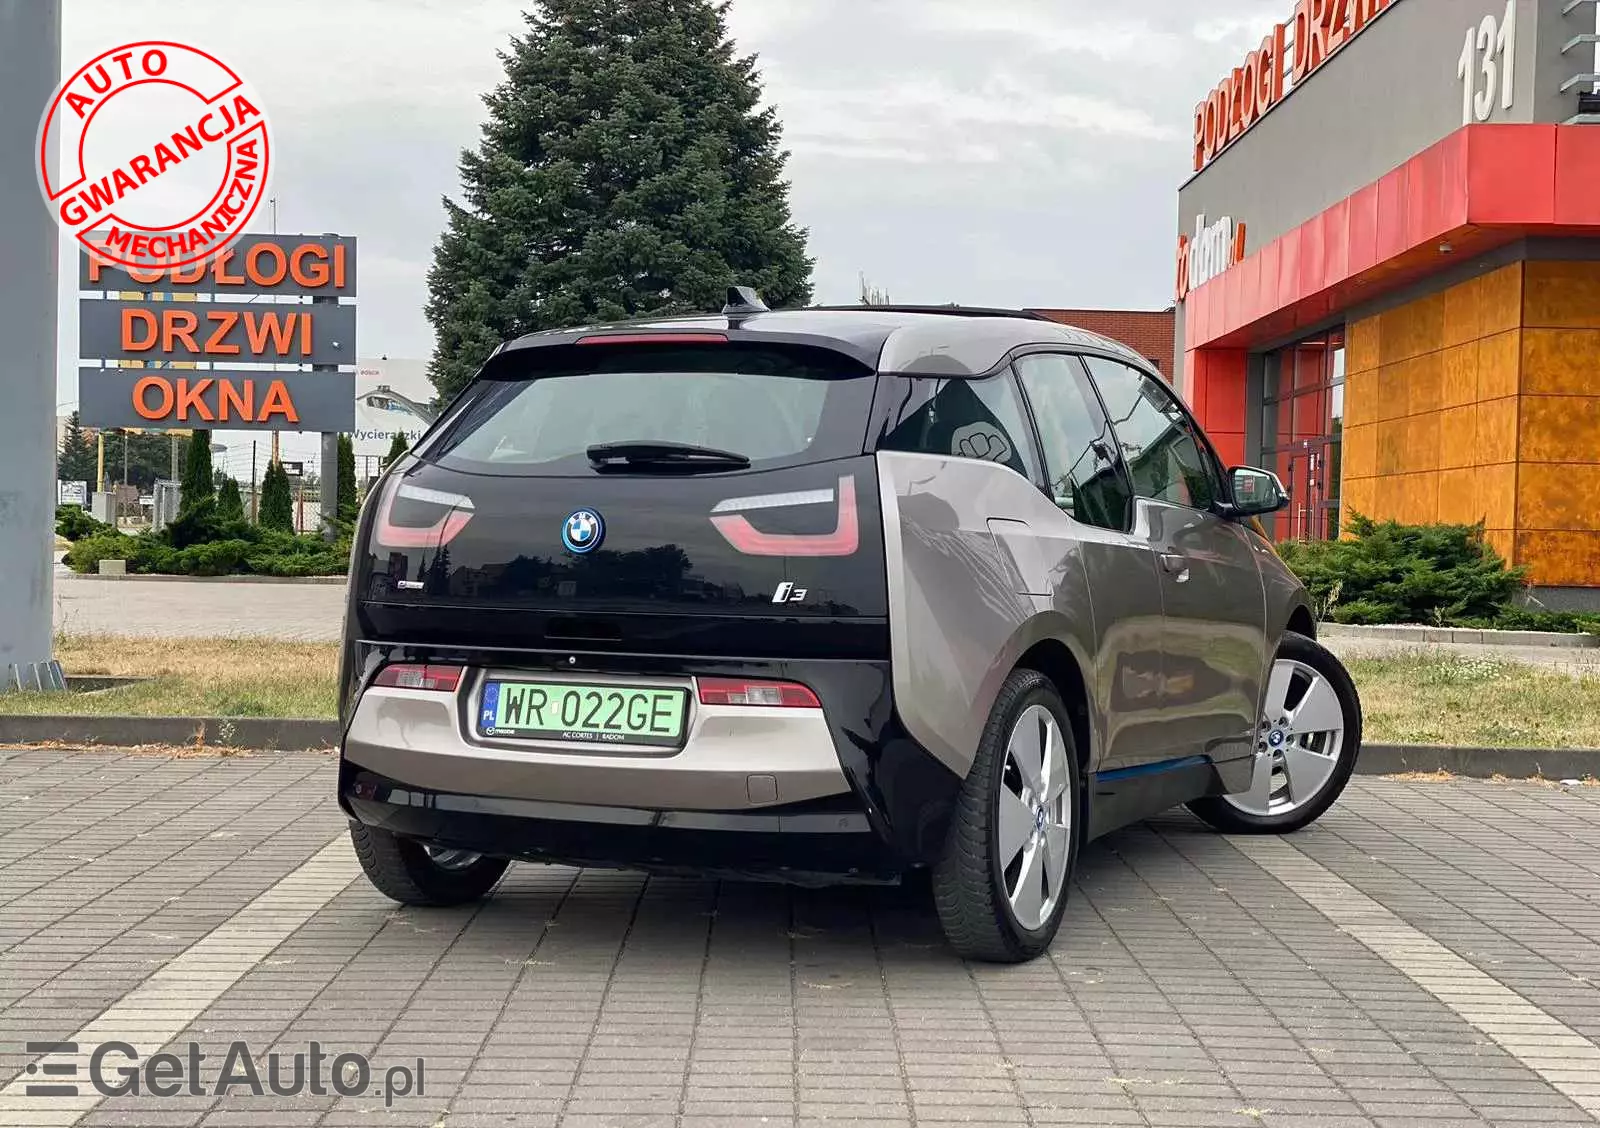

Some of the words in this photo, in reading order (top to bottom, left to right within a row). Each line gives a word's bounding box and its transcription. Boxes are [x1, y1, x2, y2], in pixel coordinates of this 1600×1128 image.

[1193, 24, 1285, 172] PODŁOGI
[1292, 0, 1391, 86] DRZ
[1457, 0, 1517, 126] 131
[87, 240, 346, 288] PODŁOGI
[120, 308, 313, 356] DRZWI
[132, 376, 300, 423] OKNA
[350, 429, 421, 441] Wycierazki
[771, 582, 808, 603] i3
[483, 711, 495, 721] PL
[504, 687, 548, 726] WR
[560, 690, 674, 733] 022GE
